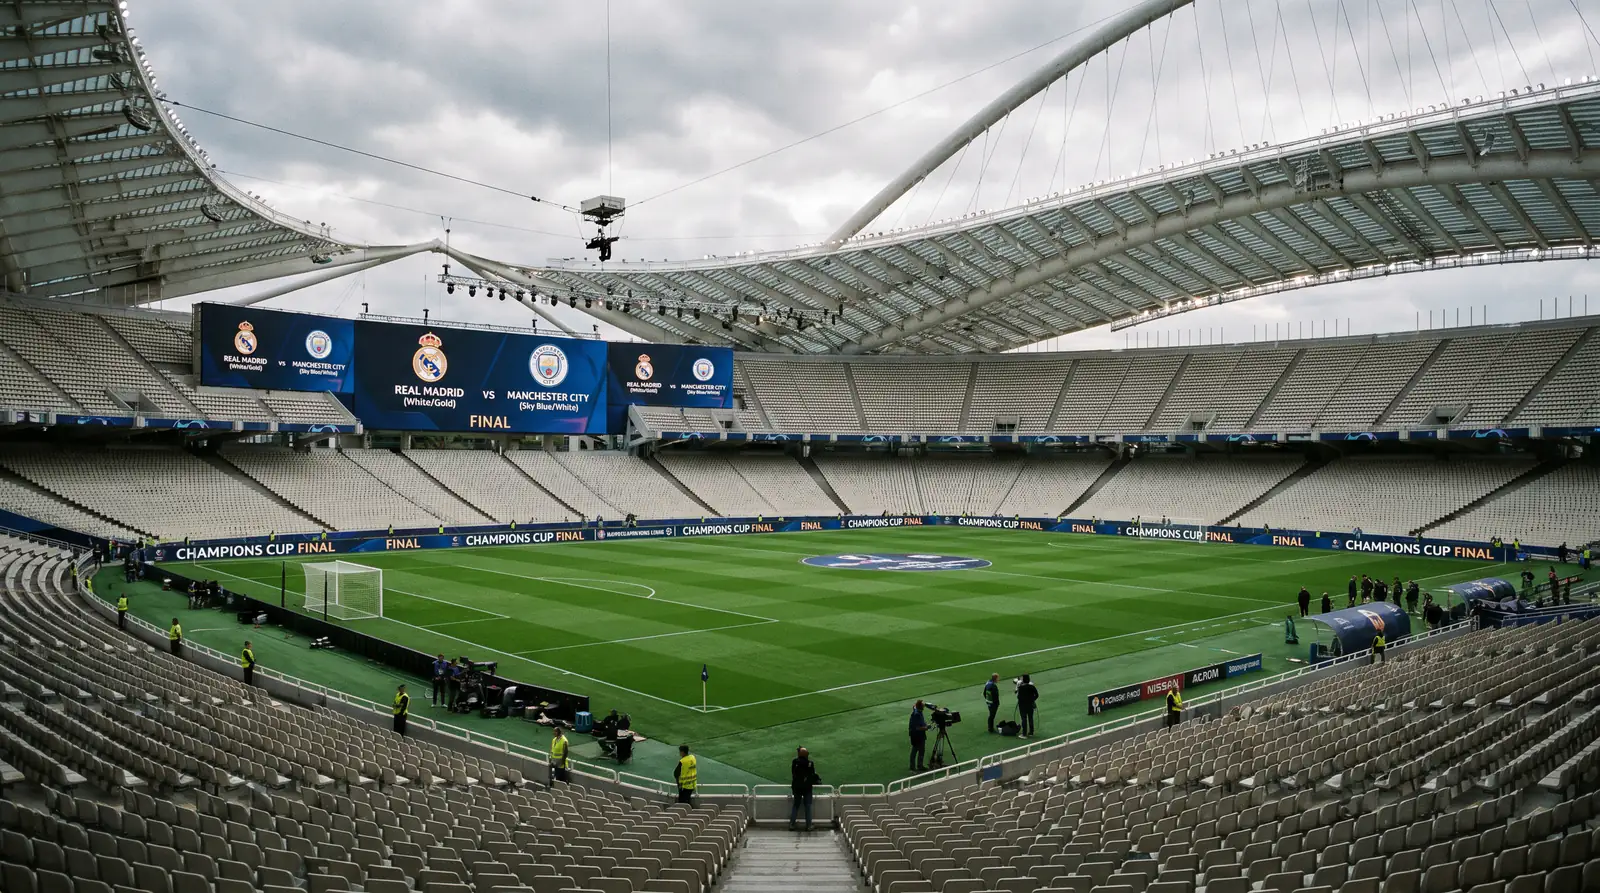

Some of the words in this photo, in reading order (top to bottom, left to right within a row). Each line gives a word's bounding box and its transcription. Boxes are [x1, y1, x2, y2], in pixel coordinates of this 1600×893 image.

[223, 355, 241, 363] REAL
[241, 356, 268, 365] MADRID
[292, 361, 332, 370] MANCHESTER
[394, 384, 422, 396] REAL
[423, 386, 465, 398] MADRID
[506, 390, 568, 402] MANCHESTER
[569, 393, 590, 403] CITY
[403, 397, 457, 410] (White/Gold)
[519, 401, 536, 412] (Sky
[536, 402, 580, 413] Blue/White)
[469, 414, 512, 429] FINAL
[800, 521, 823, 531] FINAL
[848, 518, 889, 529] CHAMPIONS
[889, 517, 904, 527] CUP
[904, 516, 923, 526] FINAL
[957, 517, 1002, 529] CHAMPIONS
[1003, 519, 1019, 529] CUP
[1019, 520, 1043, 531] FINAL
[1072, 523, 1097, 534] FINAL
[682, 524, 732, 536] CHAMPIONS
[733, 523, 751, 534] CUP
[751, 523, 774, 533] FINAL
[1126, 526, 1181, 540] CHAMPIONS
[1182, 529, 1203, 540] CUP
[1204, 531, 1234, 542] FINAL
[385, 538, 421, 550] FINAL
[466, 532, 531, 546] CHAMPIONS
[532, 531, 555, 543] CUP
[555, 531, 585, 542] FINAL
[1272, 535, 1305, 547] FINAL
[176, 544, 263, 560] CHAMPIONS
[265, 543, 295, 556] CUP
[297, 541, 336, 554] FINAL
[1345, 539, 1421, 556] CHAMPIONS
[1423, 544, 1451, 557] CUP
[1454, 546, 1495, 560] FINAL
[1147, 679, 1180, 695] NISSAN
